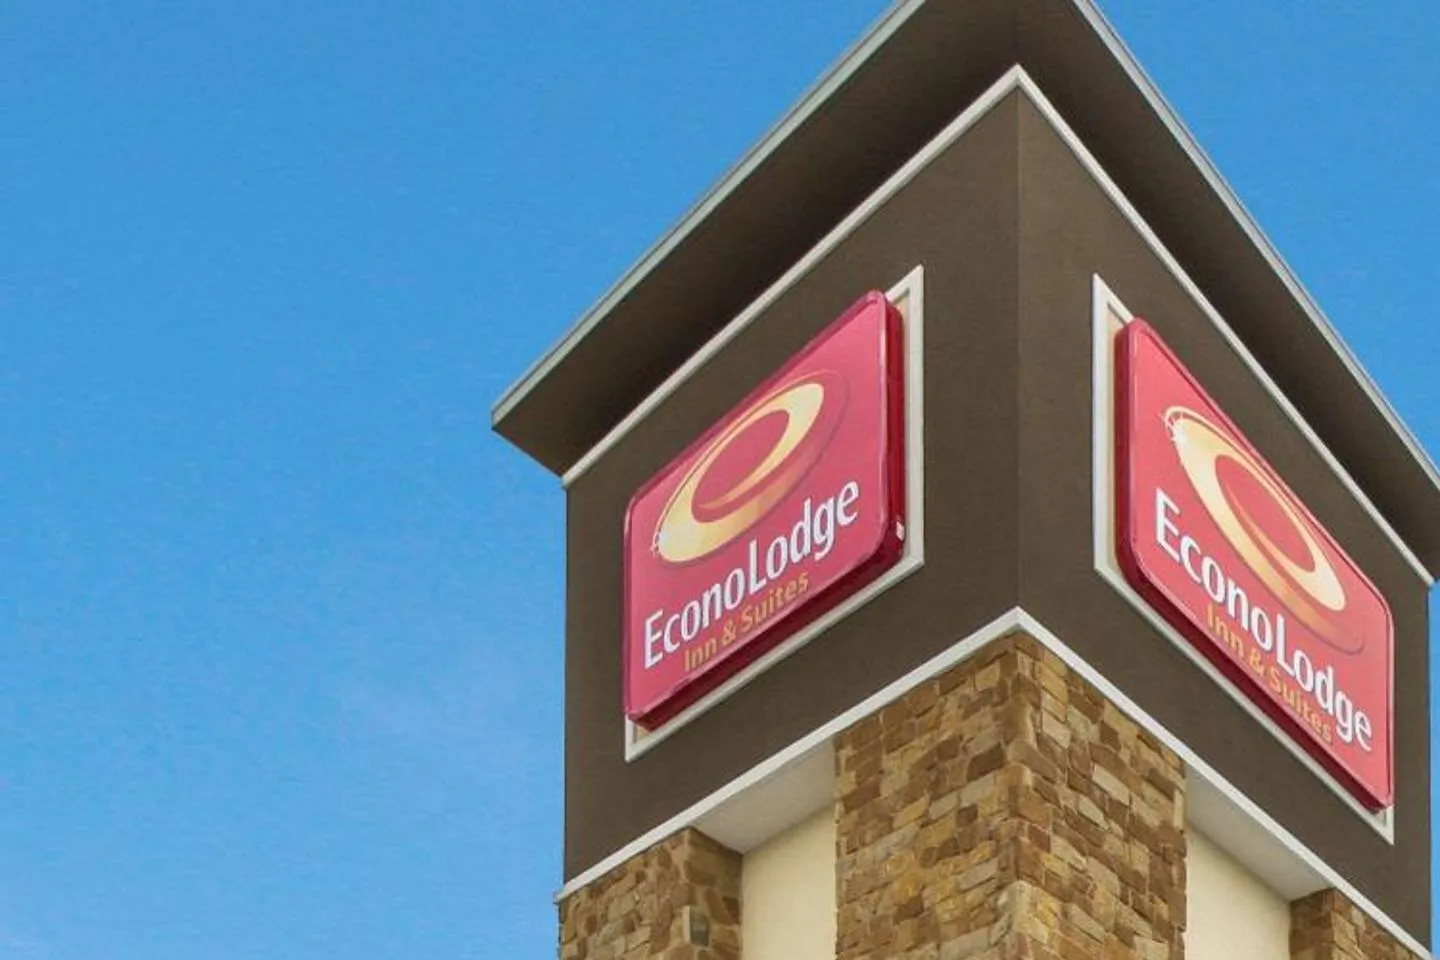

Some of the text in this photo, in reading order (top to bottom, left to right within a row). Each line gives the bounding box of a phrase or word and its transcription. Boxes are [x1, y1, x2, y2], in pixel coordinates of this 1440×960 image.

[685, 573, 809, 671] Inn & Suites
[1207, 603, 1332, 742] Inn & Suites
